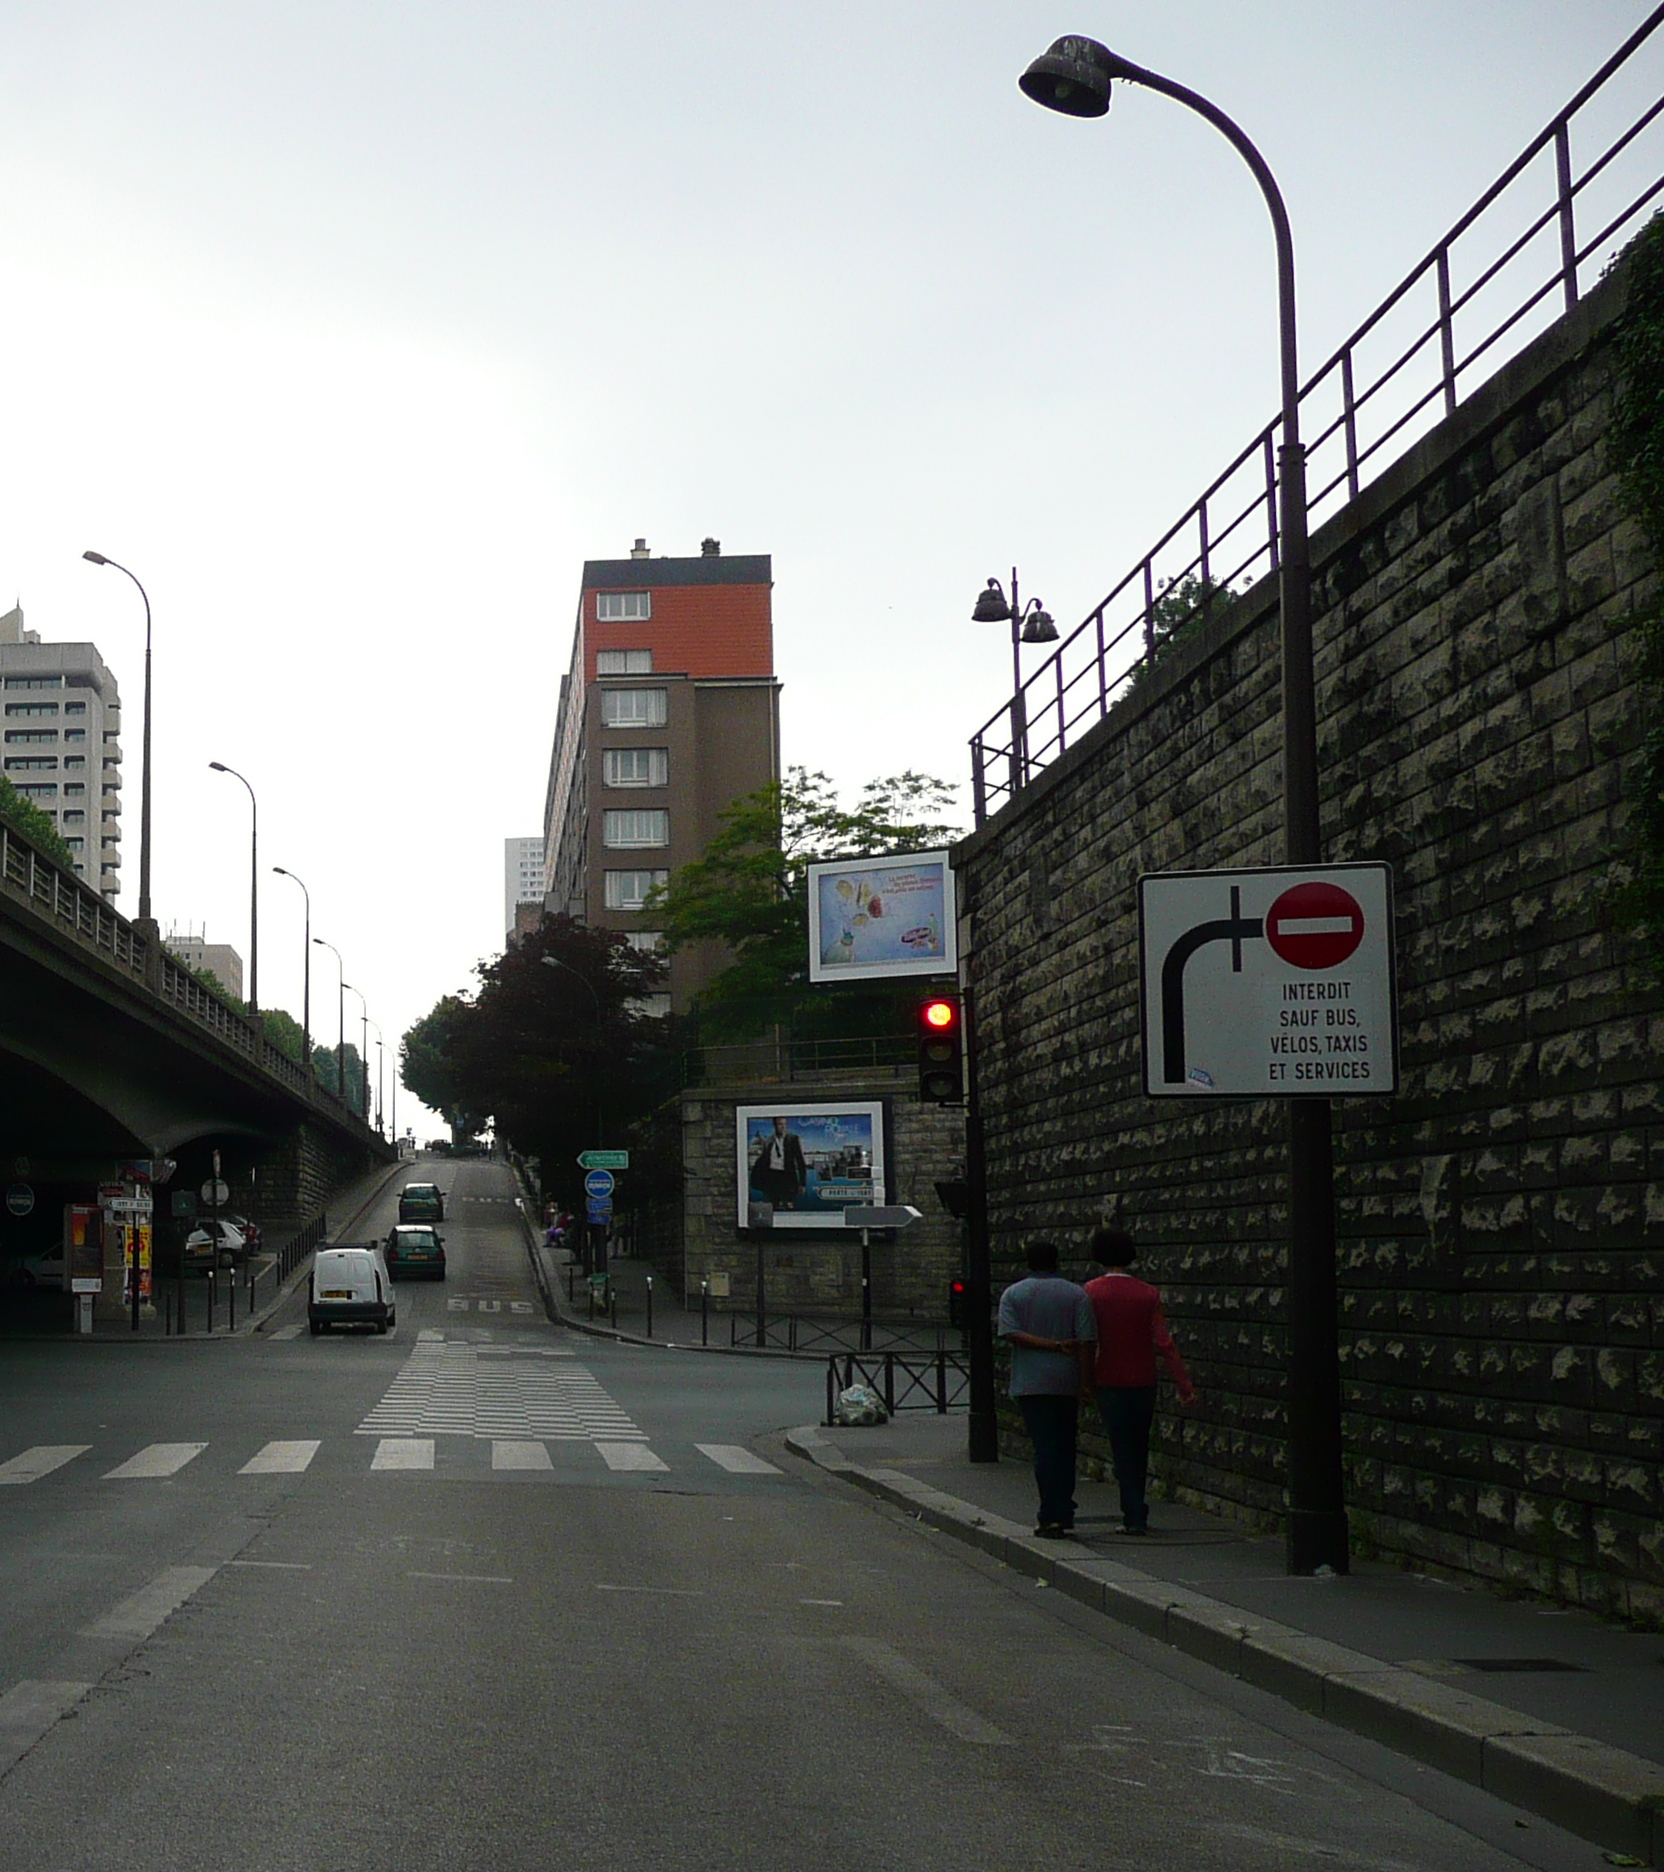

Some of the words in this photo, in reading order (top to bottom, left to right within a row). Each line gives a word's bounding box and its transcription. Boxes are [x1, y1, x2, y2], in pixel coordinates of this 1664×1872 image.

[1283, 982, 1351, 1000] INTERDIT
[1280, 1010, 1319, 1026] SAUF
[1326, 1008, 1360, 1028] BUS,
[1271, 1032, 1322, 1055] VÉLOS,
[1325, 1035, 1367, 1052] TAXIS
[1270, 1063, 1286, 1080] ET
[1295, 1062, 1370, 1079] SERVICES
[447, 1299, 534, 1314] BUS
